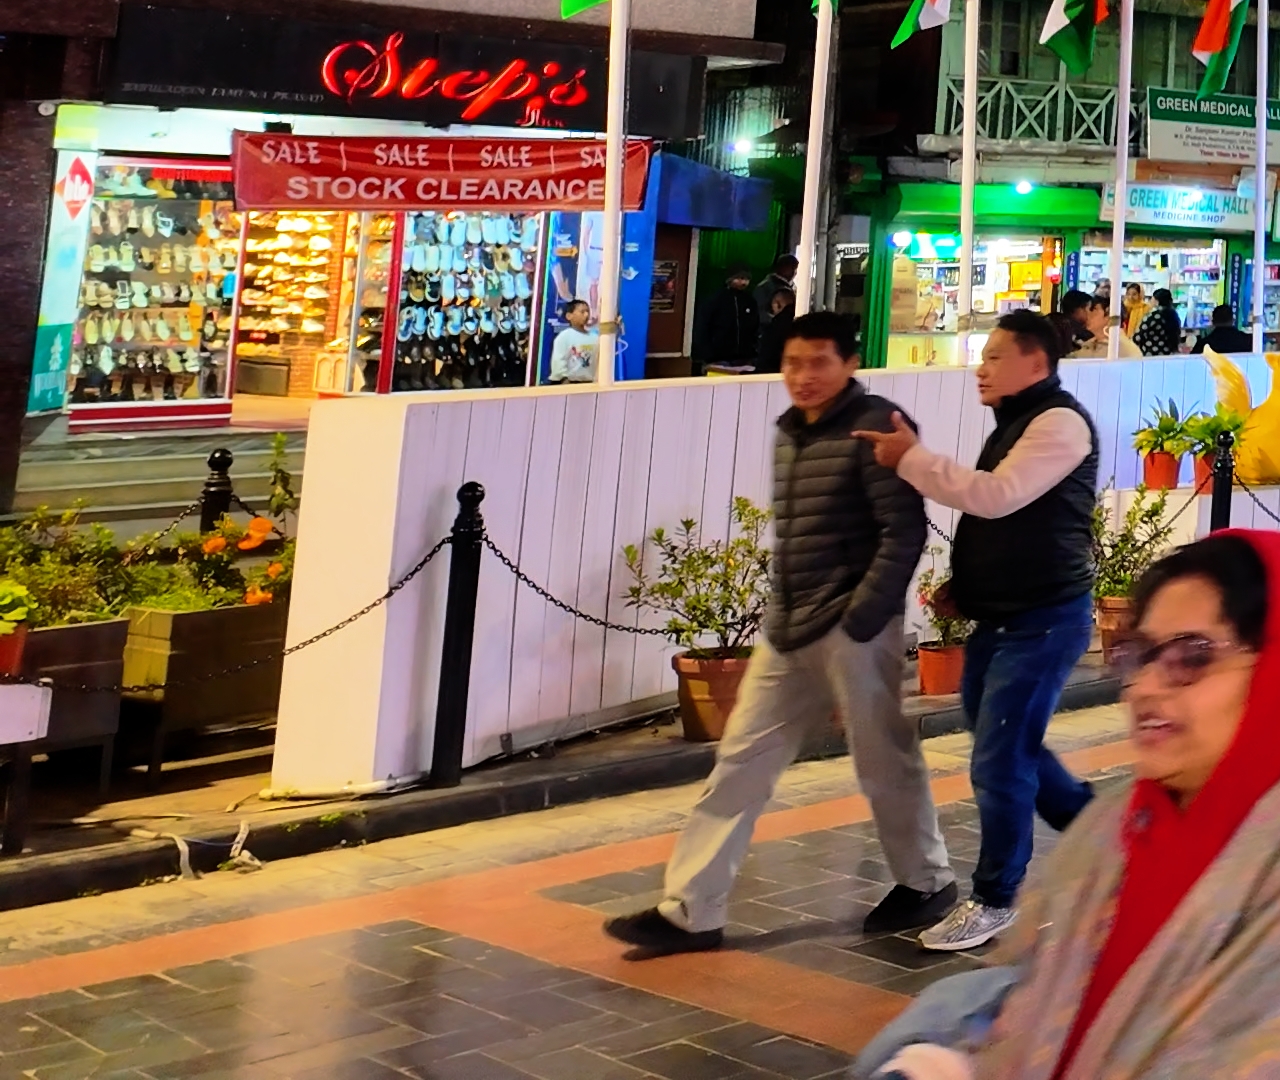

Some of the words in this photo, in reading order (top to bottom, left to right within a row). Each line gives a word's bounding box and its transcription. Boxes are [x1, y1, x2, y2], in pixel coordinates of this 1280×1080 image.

[321, 32, 589, 120] Step's
[1156, 96, 1198, 113] GREEN
[1200, 100, 1252, 118] MEDICAL
[261, 141, 322, 165] SALE
[373, 142, 430, 167] SALE
[480, 144, 533, 168] SALE
[286, 177, 405, 201] STOCK
[415, 177, 606, 201] CLEARANCE
[1129, 187, 1168, 209] GREEN
[1171, 190, 1220, 213] MEDICAL
[1222, 195, 1250, 214] HALL
[1153, 211, 1199, 223] MEDICINE
[1201, 214, 1226, 224] SHOP
